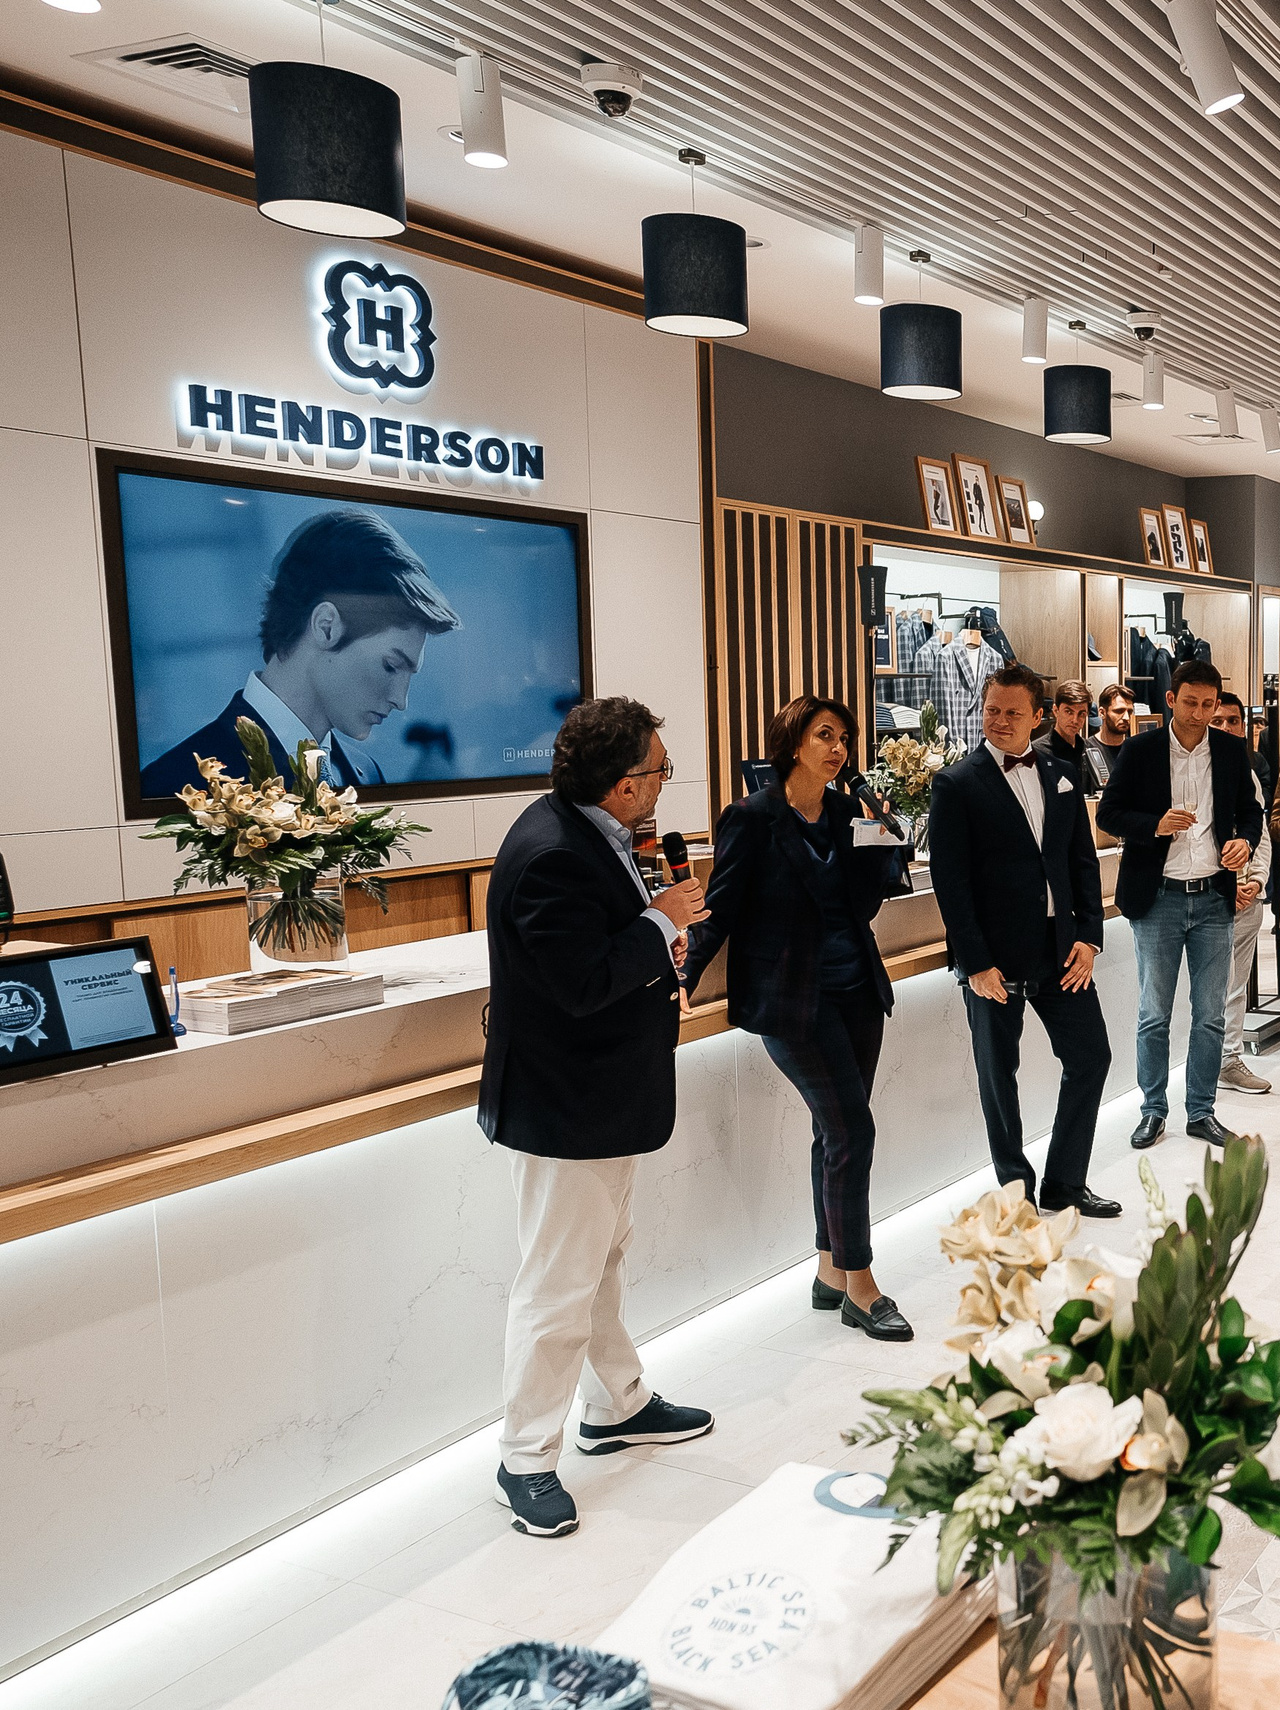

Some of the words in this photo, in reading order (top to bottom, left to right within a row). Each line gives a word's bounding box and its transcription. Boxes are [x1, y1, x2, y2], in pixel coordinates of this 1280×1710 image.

[356, 297, 406, 354] H
[187, 384, 545, 481] HENDERSON
[63, 969, 133, 987] УНИКАЛЬНЫЙ
[81, 979, 120, 991] СЕРВИС
[0, 990, 23, 1009] 24
[691, 1572, 785, 1610] BALTIC
[777, 1590, 807, 1631] SEA
[708, 1616, 738, 1633] HDN
[669, 1625, 716, 1673] BLACK
[730, 1639, 781, 1670] SEA
